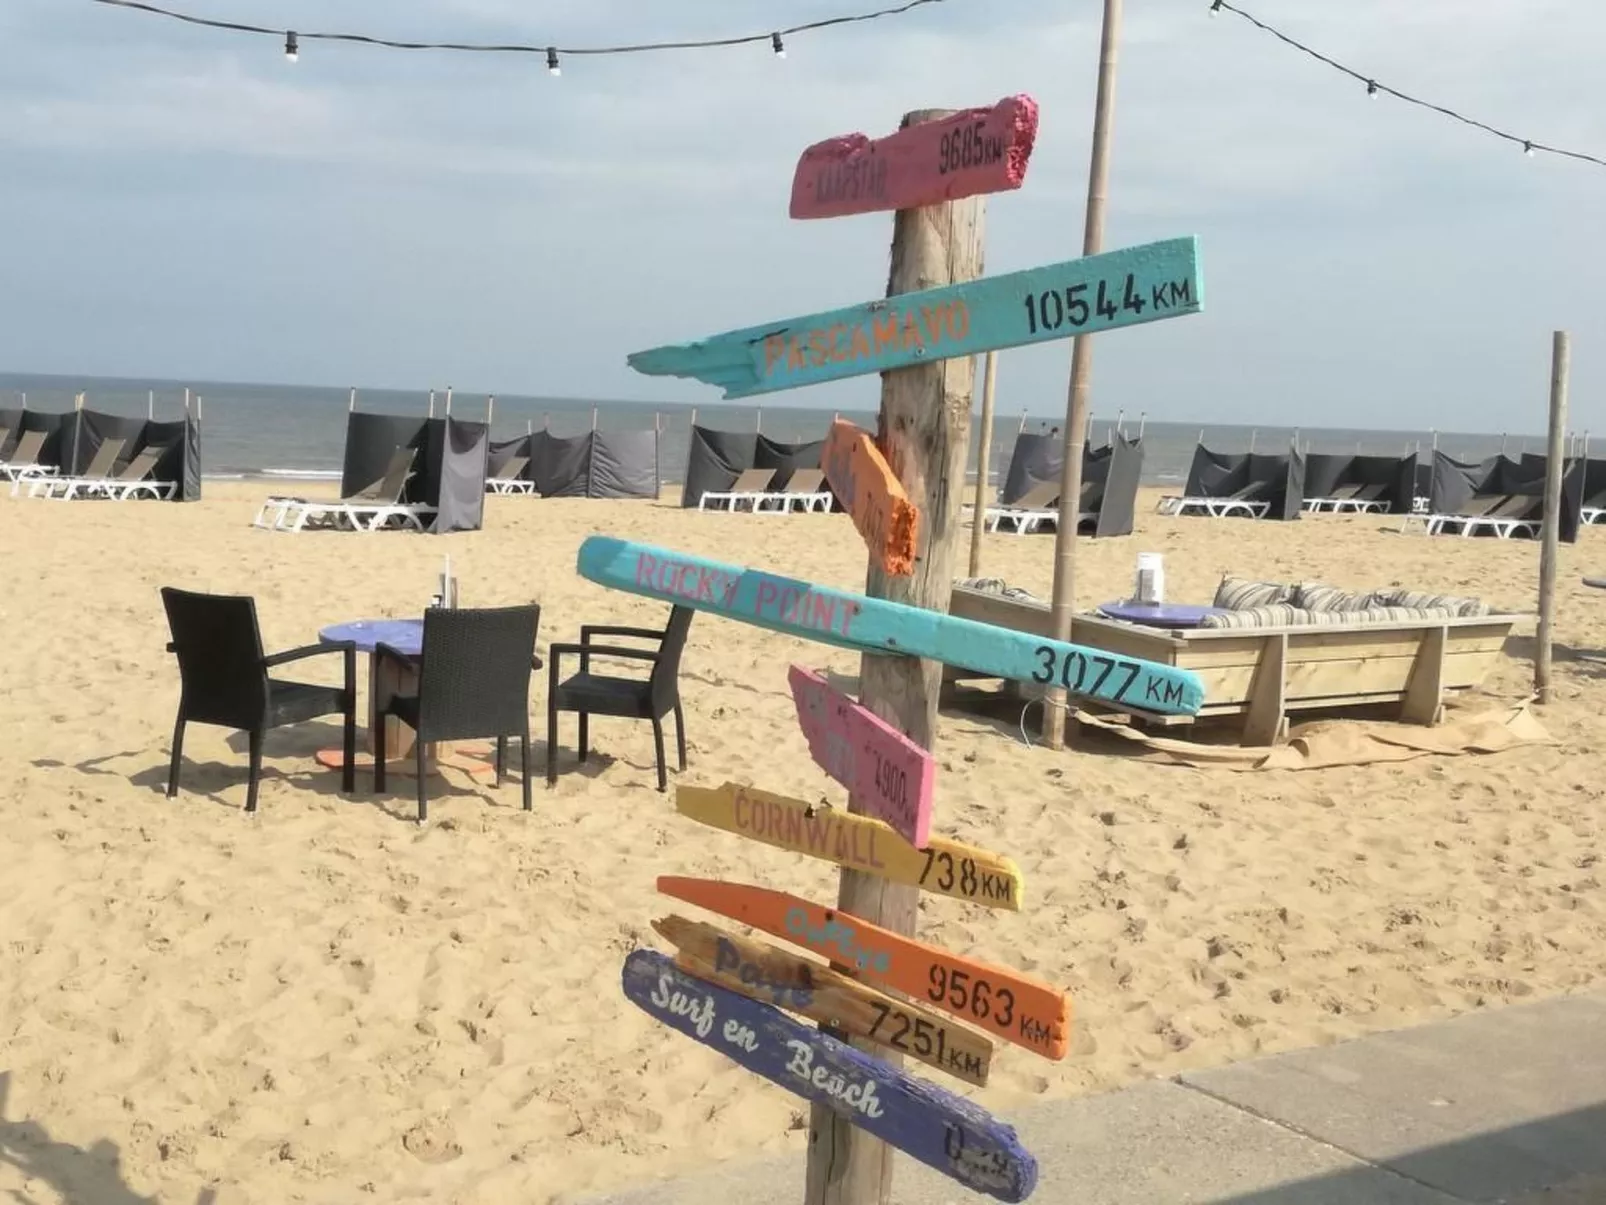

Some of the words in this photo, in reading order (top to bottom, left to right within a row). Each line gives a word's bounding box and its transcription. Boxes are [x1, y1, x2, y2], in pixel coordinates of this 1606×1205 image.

[1024, 273, 1147, 335] 10544
[1151, 278, 1191, 312] KM
[634, 551, 742, 608] ROCKY
[755, 580, 861, 637] POINT
[1031, 646, 1141, 701] 3077
[1145, 676, 1185, 706] KM
[733, 794, 885, 869] CORNWALL
[868, 1001, 945, 1064] 7251
[928, 964, 1014, 1028] 9563
[1020, 1014, 1051, 1047] KM
[651, 974, 716, 1038] Surf
[723, 1020, 759, 1053] en
[785, 1040, 884, 1118] Beach
